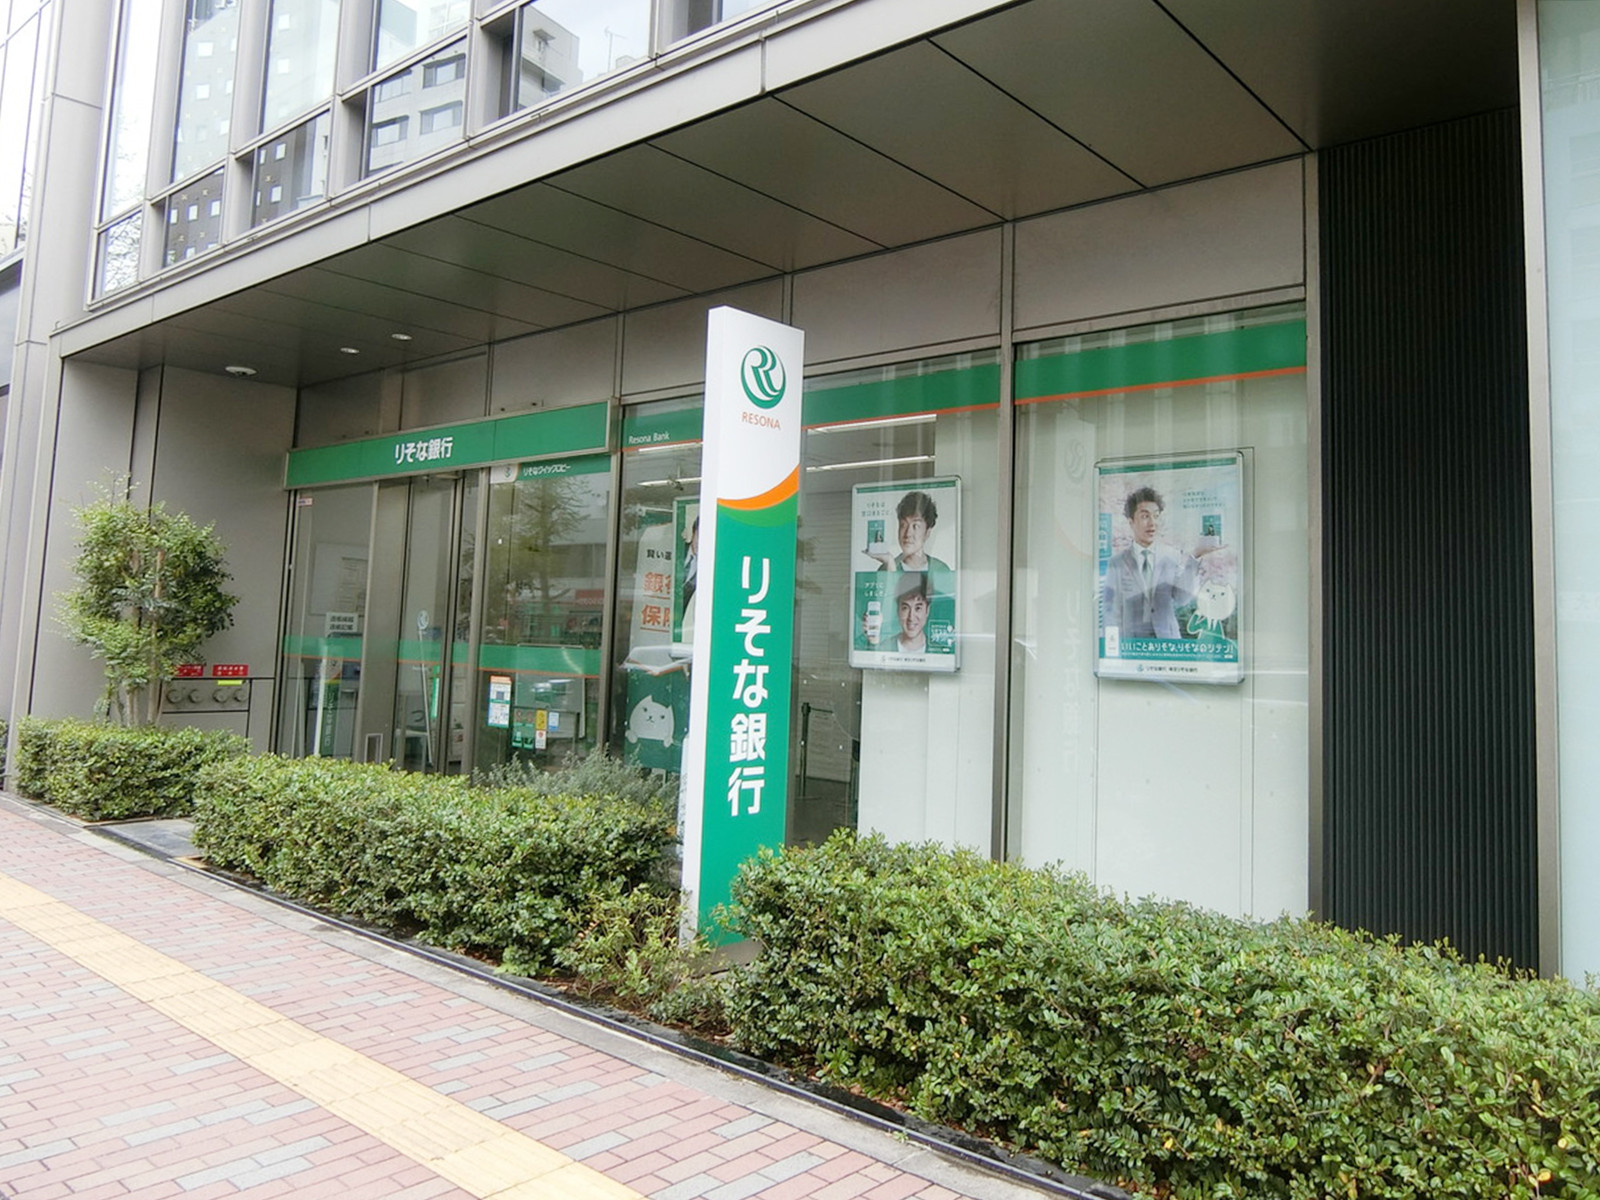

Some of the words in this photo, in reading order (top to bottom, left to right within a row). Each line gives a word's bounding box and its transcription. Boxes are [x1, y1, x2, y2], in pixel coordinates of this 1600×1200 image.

[741, 412, 781, 430] RESONA
[628, 435, 651, 444] Resona
[653, 430, 671, 442] Bank
[394, 436, 454, 465] りそな銀行
[727, 555, 771, 817] りそな銀行
